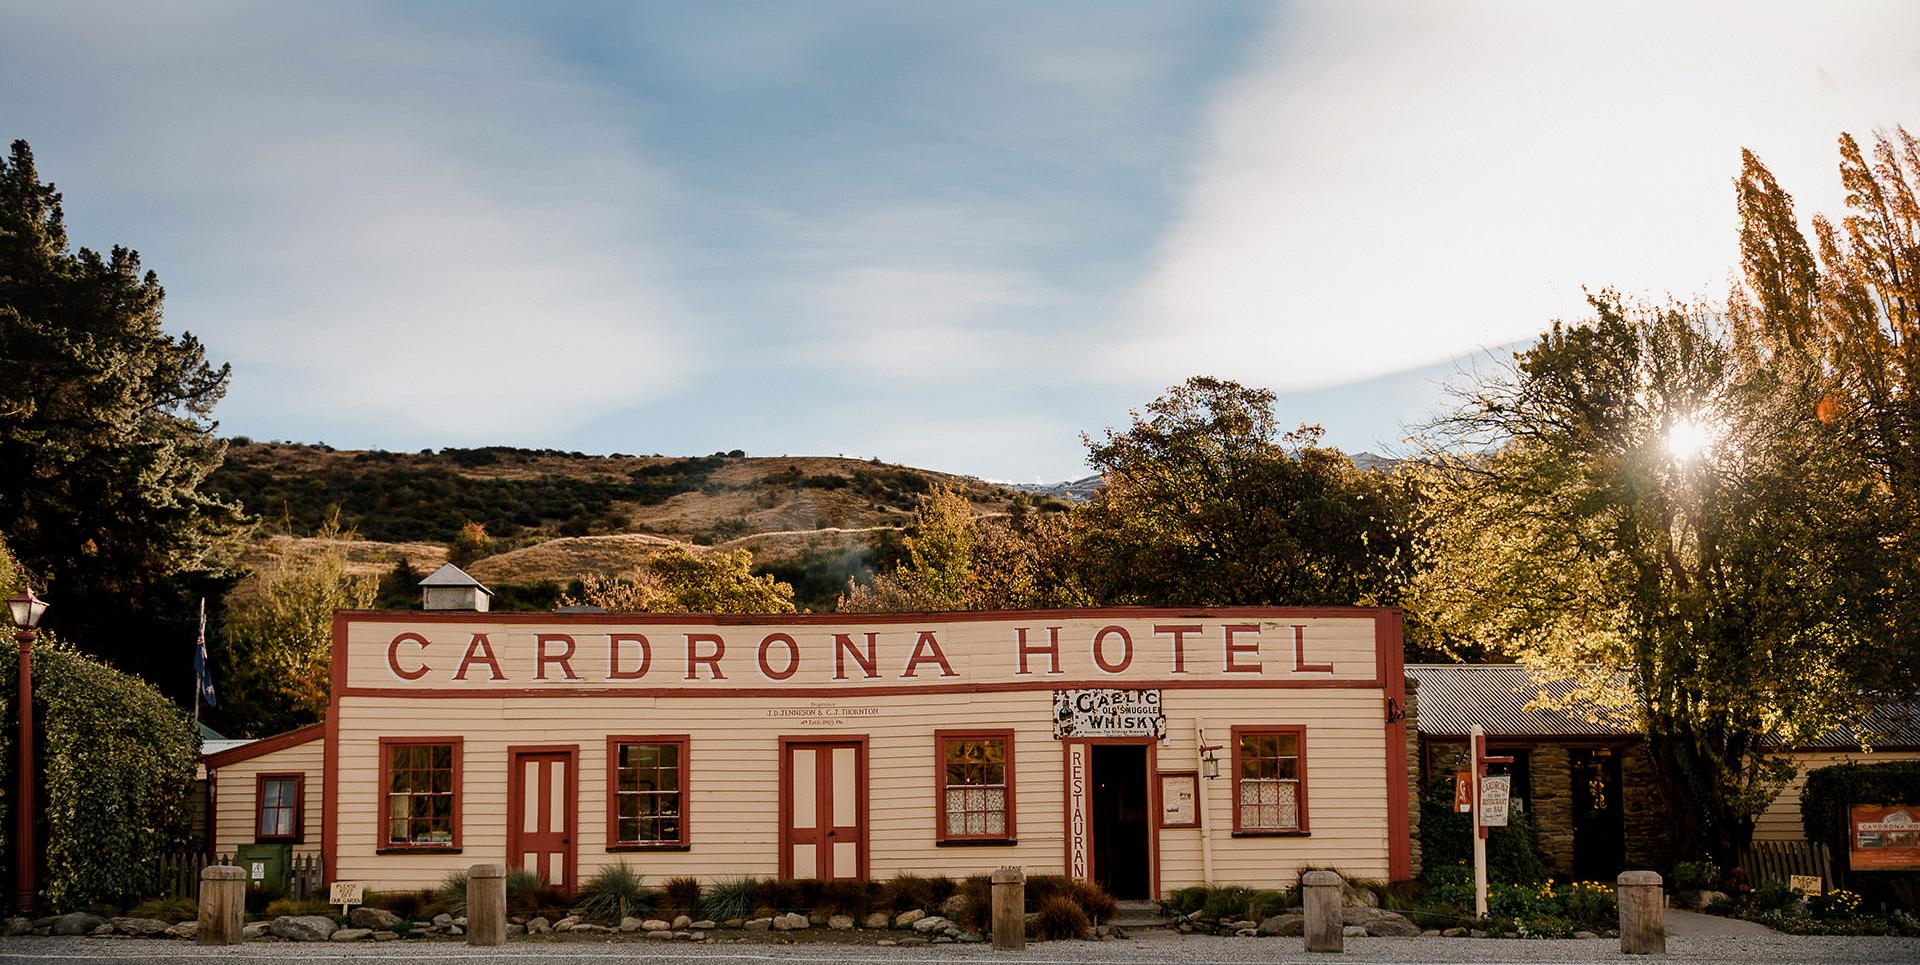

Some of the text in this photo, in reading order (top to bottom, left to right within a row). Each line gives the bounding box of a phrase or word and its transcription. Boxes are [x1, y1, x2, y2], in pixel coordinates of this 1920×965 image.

[387, 623, 1334, 682] CARDRONA HOTEL
[842, 707, 880, 716] THORNTON
[1076, 690, 1158, 713] GAELIC
[1088, 715, 1161, 729] WHISKY
[1072, 752, 1084, 881] RESTAURAN
